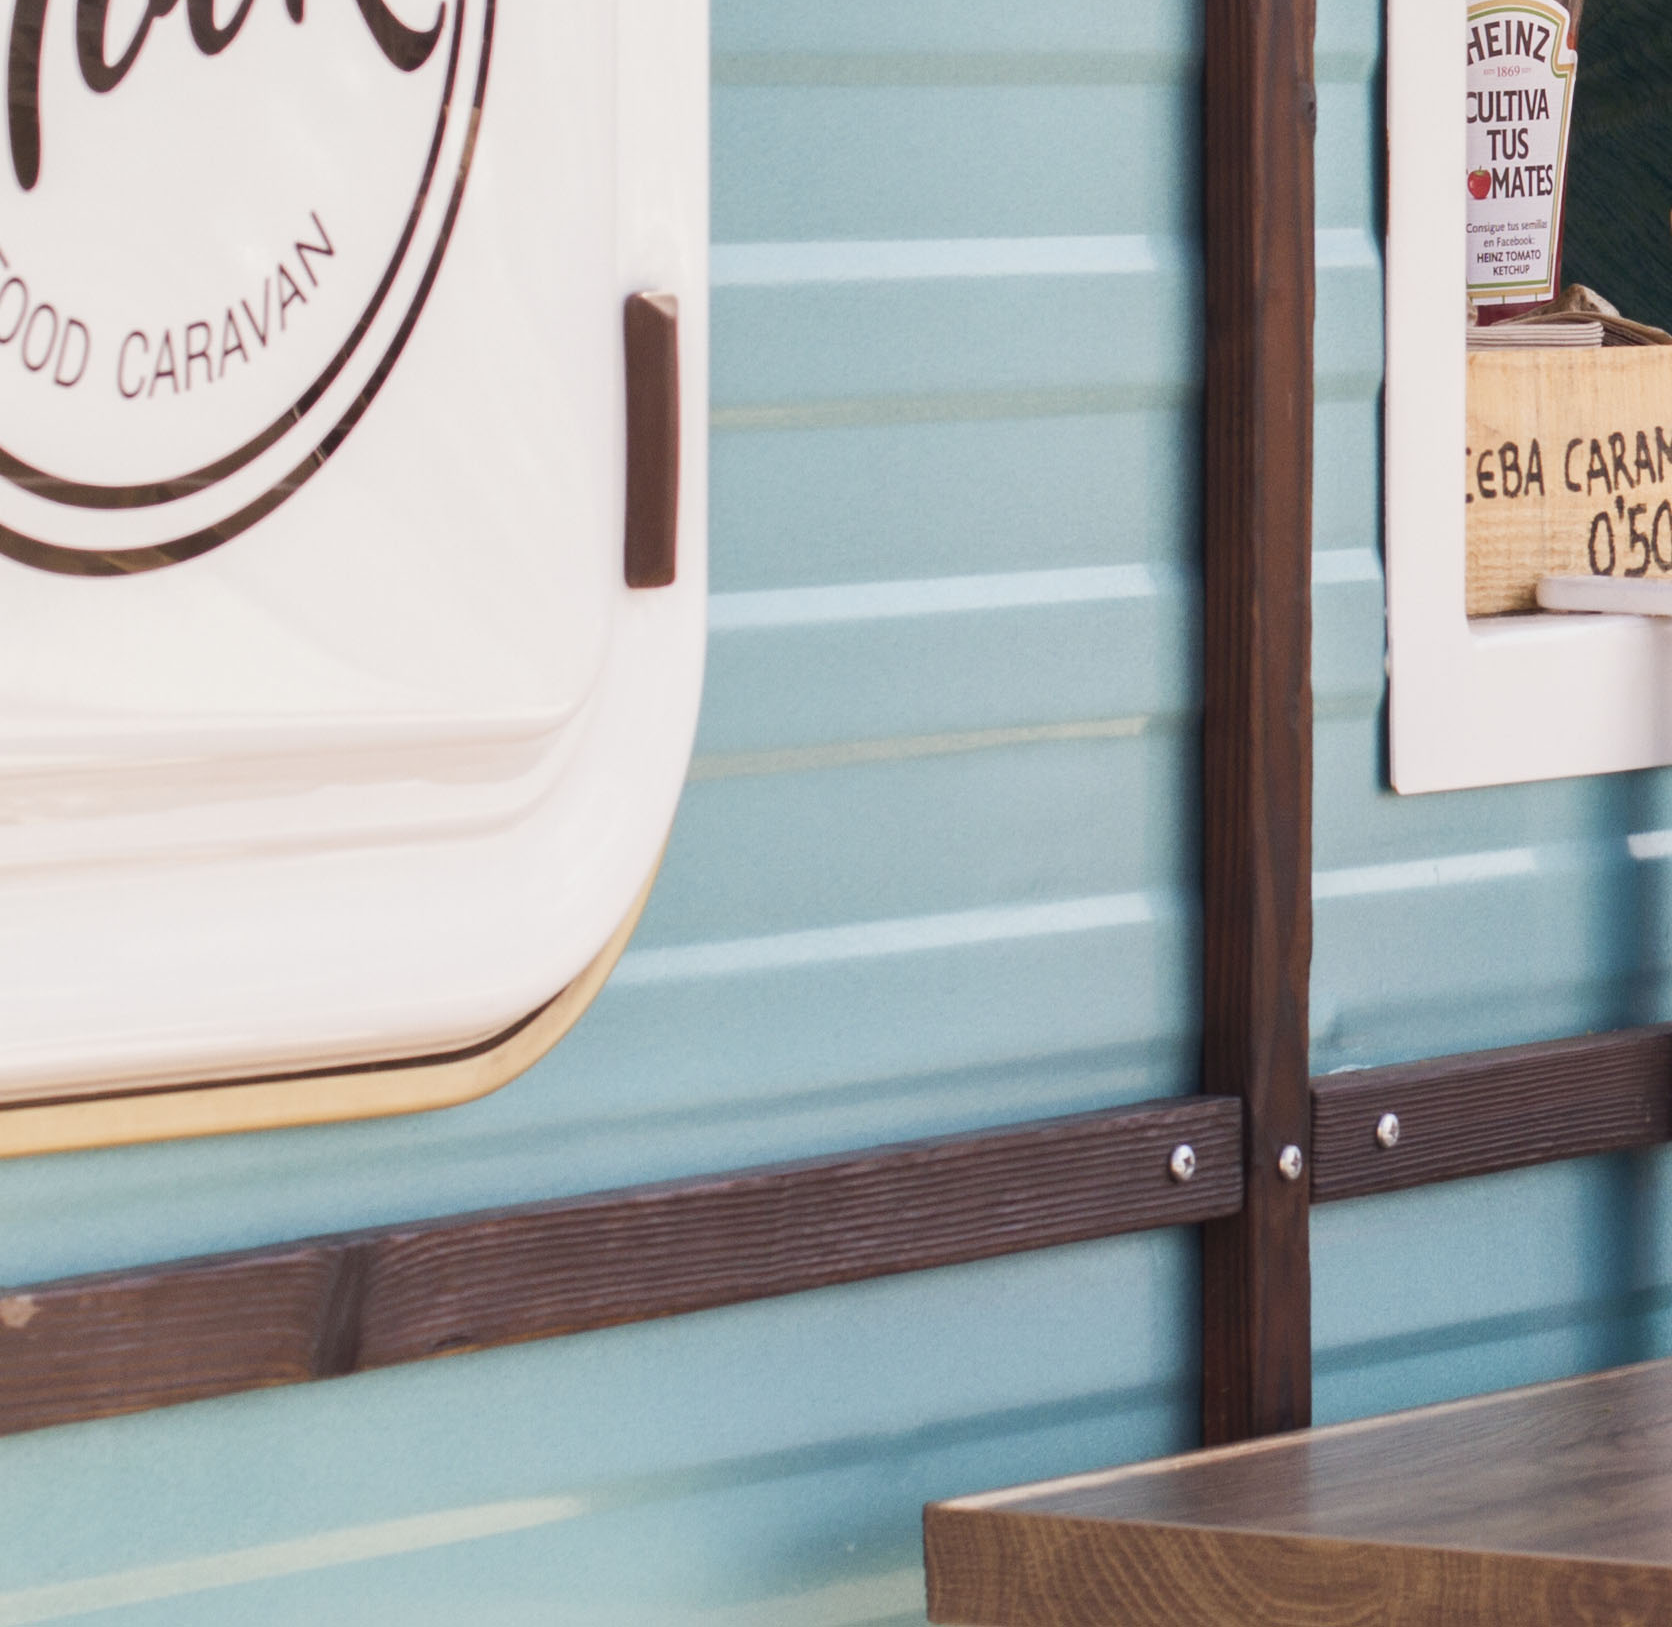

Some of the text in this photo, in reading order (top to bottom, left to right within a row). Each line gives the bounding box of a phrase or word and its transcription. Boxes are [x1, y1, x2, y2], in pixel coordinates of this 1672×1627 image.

[1467, 20, 1550, 66] HEINZ
[1496, 65, 1521, 77] 1869
[1467, 89, 1549, 123] CULTIVA
[1487, 128, 1529, 160] TUS
[1466, 223, 1505, 234] Consigue
[1507, 221, 1519, 231] tus
[1484, 238, 1494, 247] en
[1477, 250, 1541, 263] HEINZ TOMATO
[1493, 264, 1530, 275] KETCHUP
[0, 210, 335, 399] OOD CARAVAN
[1467, 438, 1546, 503] EBA
